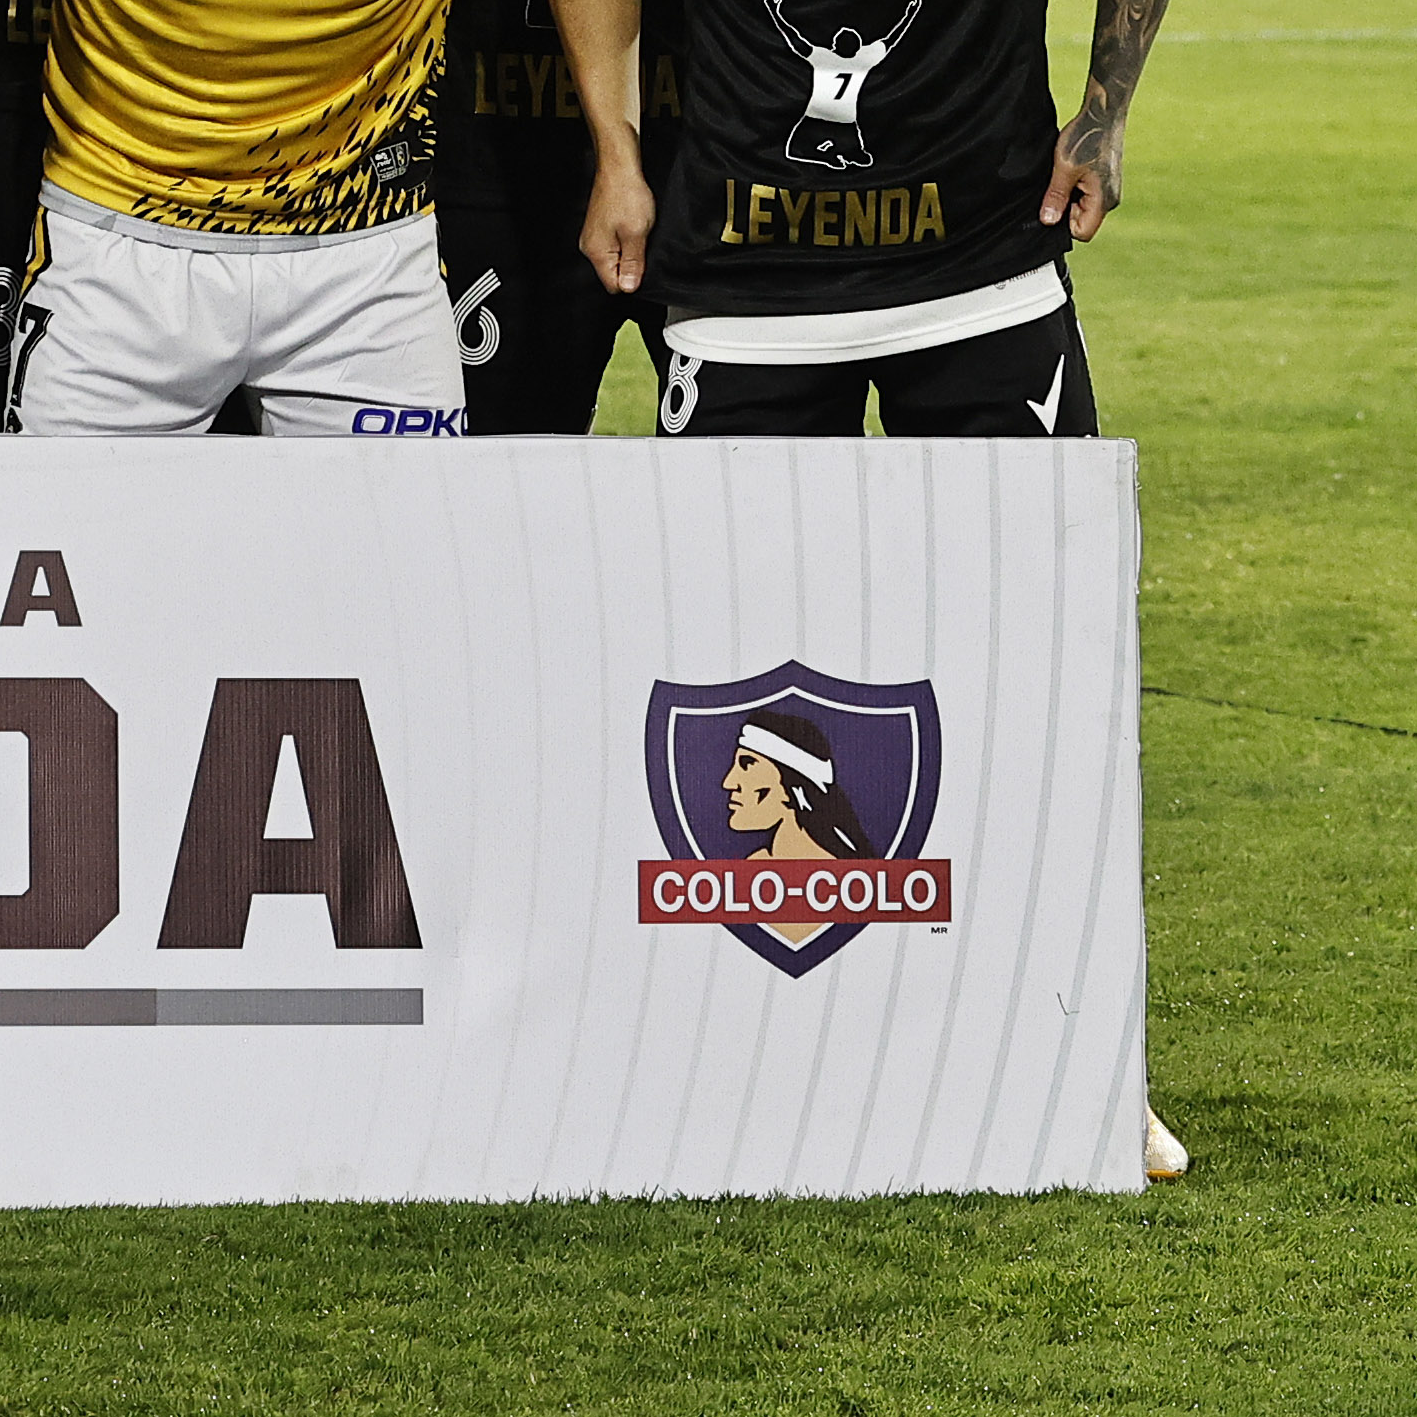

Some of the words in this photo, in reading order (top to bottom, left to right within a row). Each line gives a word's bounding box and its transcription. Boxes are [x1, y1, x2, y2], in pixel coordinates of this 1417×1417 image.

[831, 72, 853, 100] 7
[720, 177, 948, 247] LEYENDA
[652, 869, 938, 913] COLO-COLO
[930, 926, 948, 934] MR
